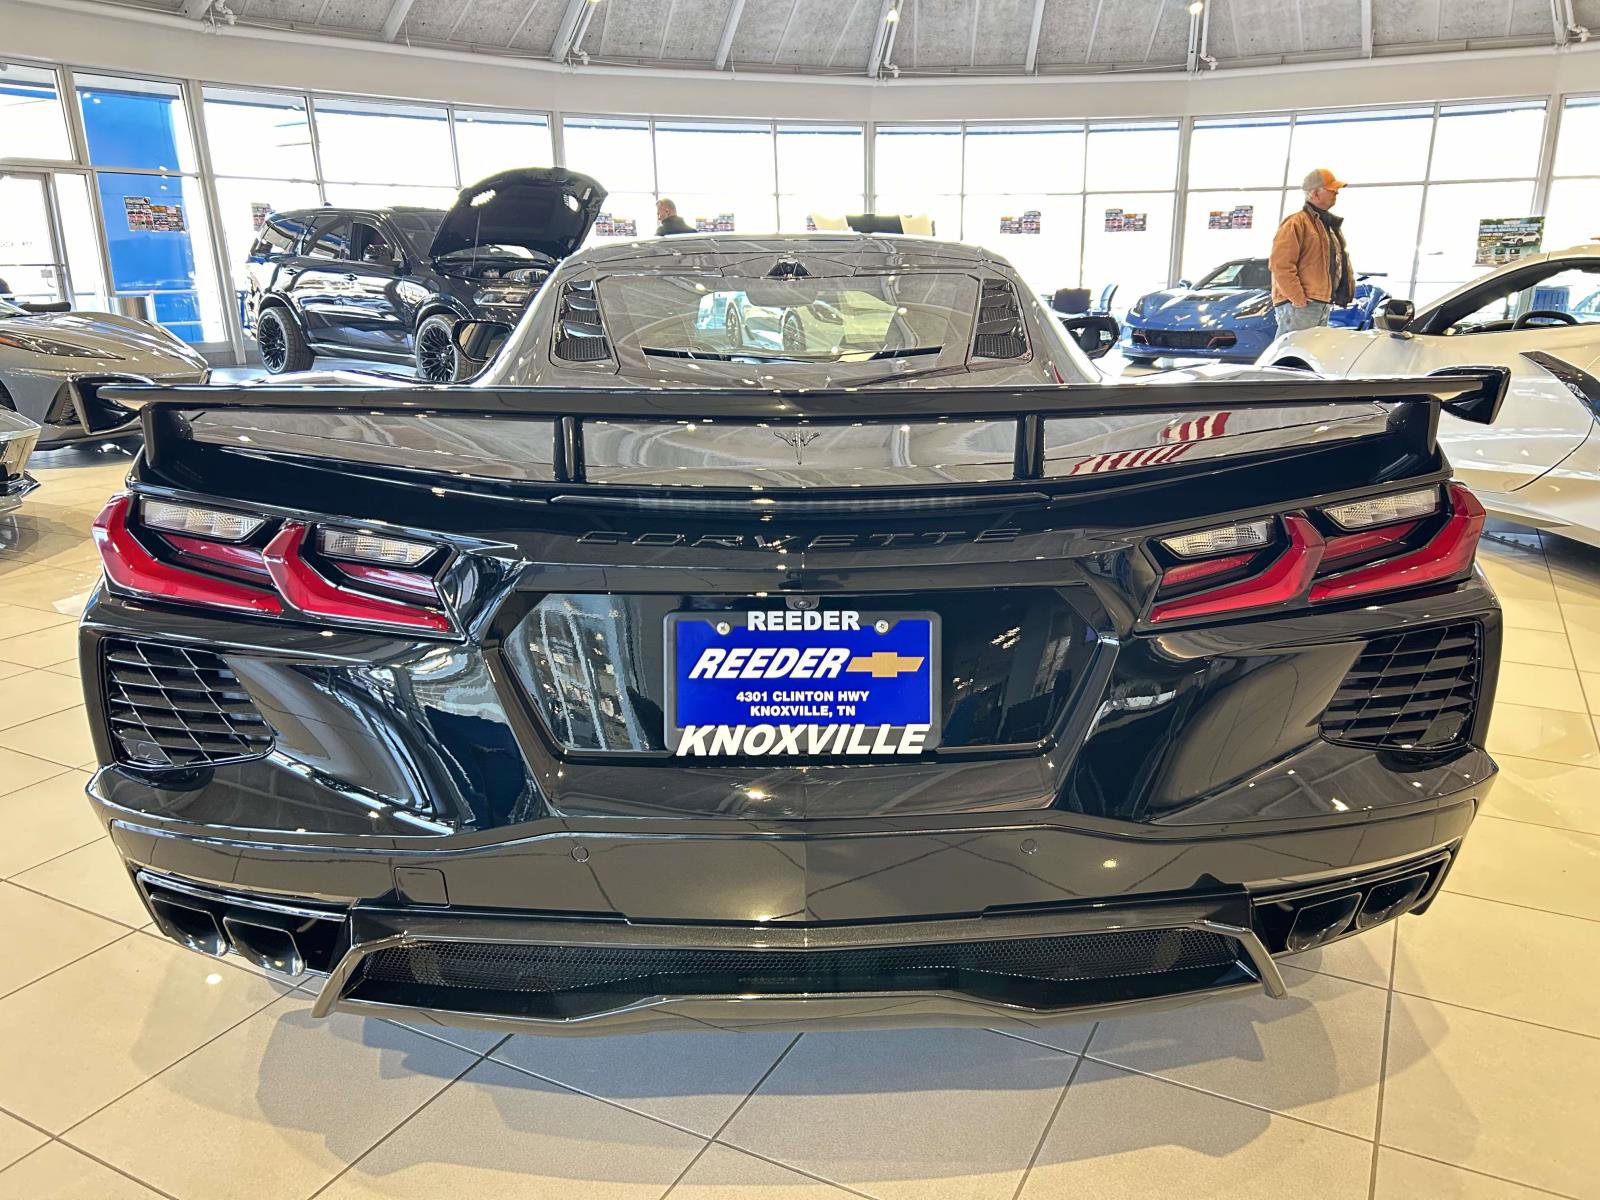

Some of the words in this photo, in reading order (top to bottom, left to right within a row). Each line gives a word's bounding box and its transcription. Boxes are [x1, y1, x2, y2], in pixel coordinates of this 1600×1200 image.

[576, 527, 1022, 549] CORVETTE
[747, 610, 860, 631] REEDER
[688, 647, 850, 679] REEDER
[736, 691, 768, 702] 4301
[772, 691, 831, 702] CLINTON
[837, 691, 870, 702] HWY
[750, 705, 833, 718] KNOXVILLE,
[836, 705, 856, 717] TN
[676, 723, 930, 757] KNOXVILLE
